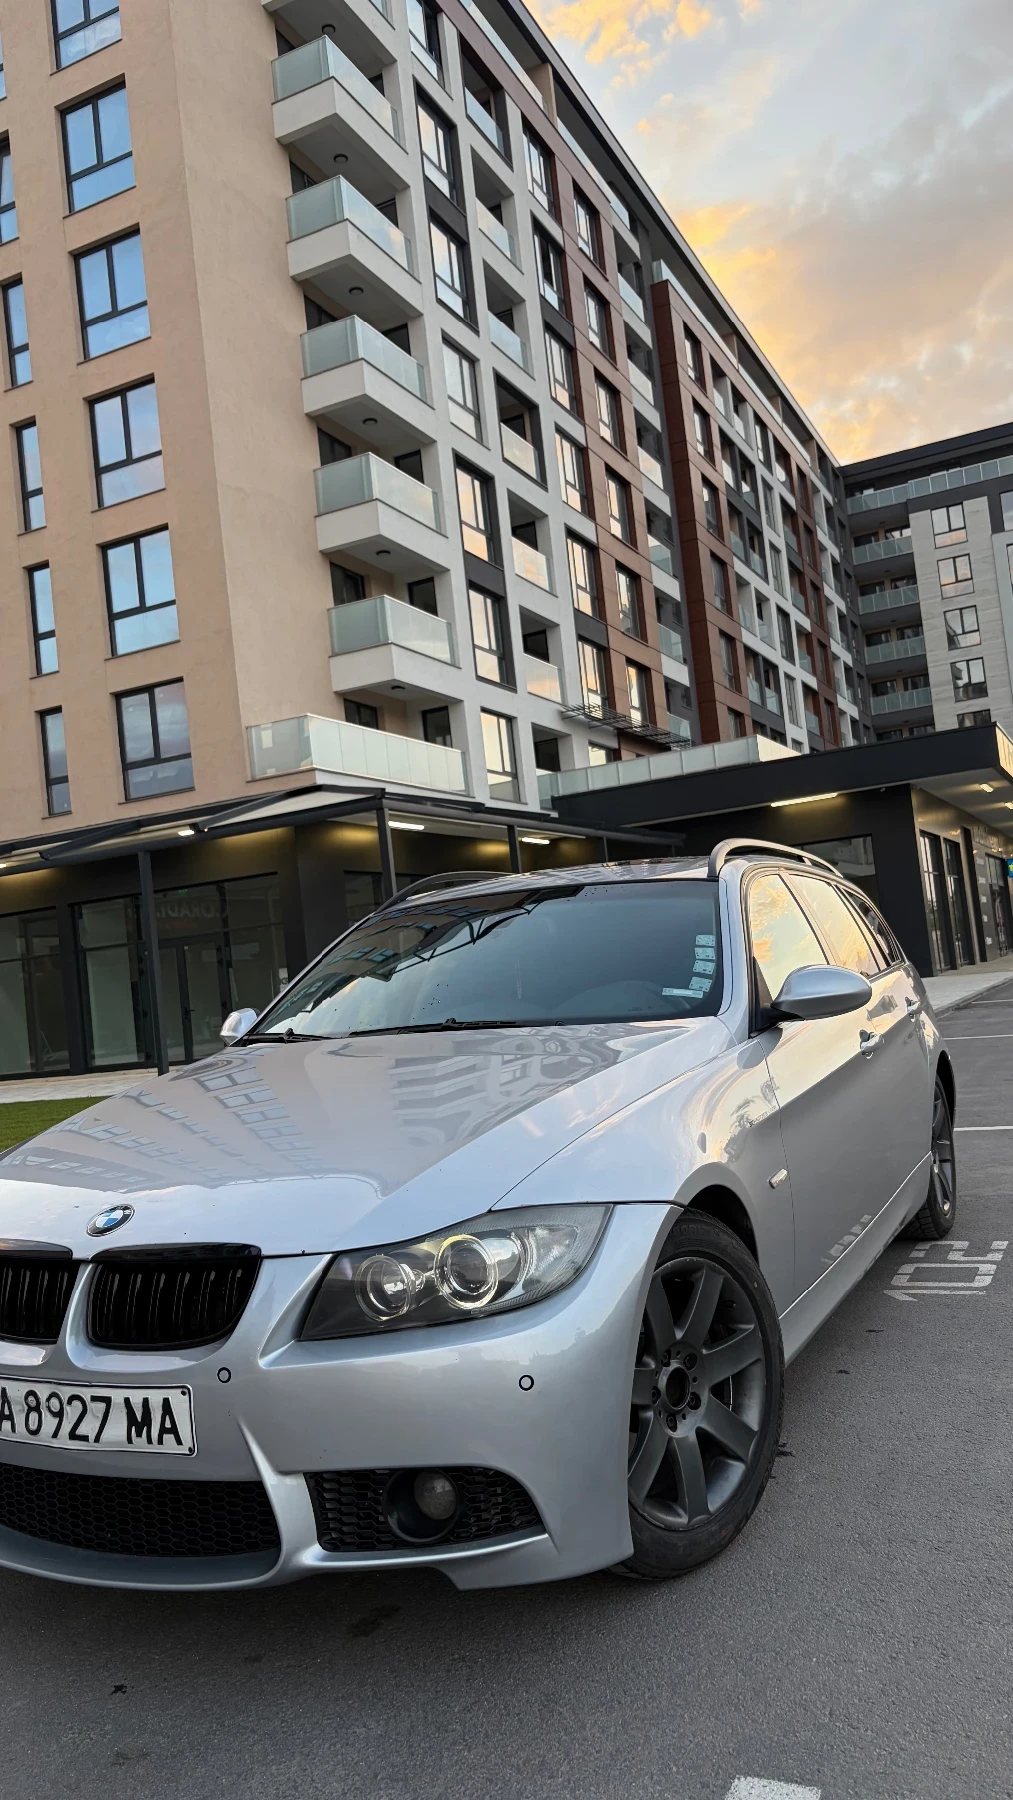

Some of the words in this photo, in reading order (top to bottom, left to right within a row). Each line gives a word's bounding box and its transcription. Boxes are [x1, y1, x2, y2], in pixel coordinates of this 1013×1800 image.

[883, 1241, 1009, 1302] 102
[23, 1389, 112, 1443] 8927
[124, 1397, 183, 1446] MA
